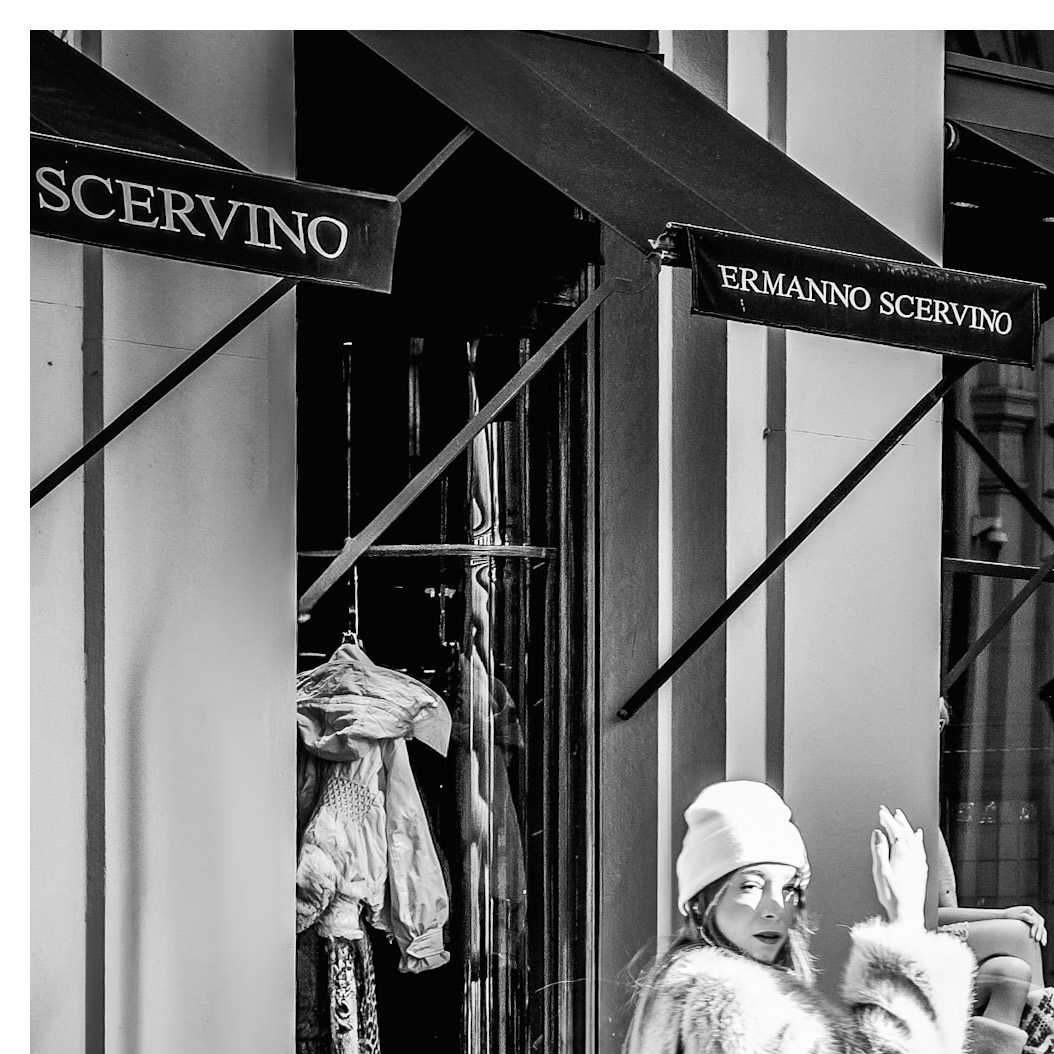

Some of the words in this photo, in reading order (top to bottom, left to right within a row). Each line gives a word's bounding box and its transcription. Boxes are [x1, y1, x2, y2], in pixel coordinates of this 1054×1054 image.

[35, 167, 348, 259] SCERVINO
[718, 264, 871, 310] ERMANNO
[880, 292, 1012, 335] SCERVINO
